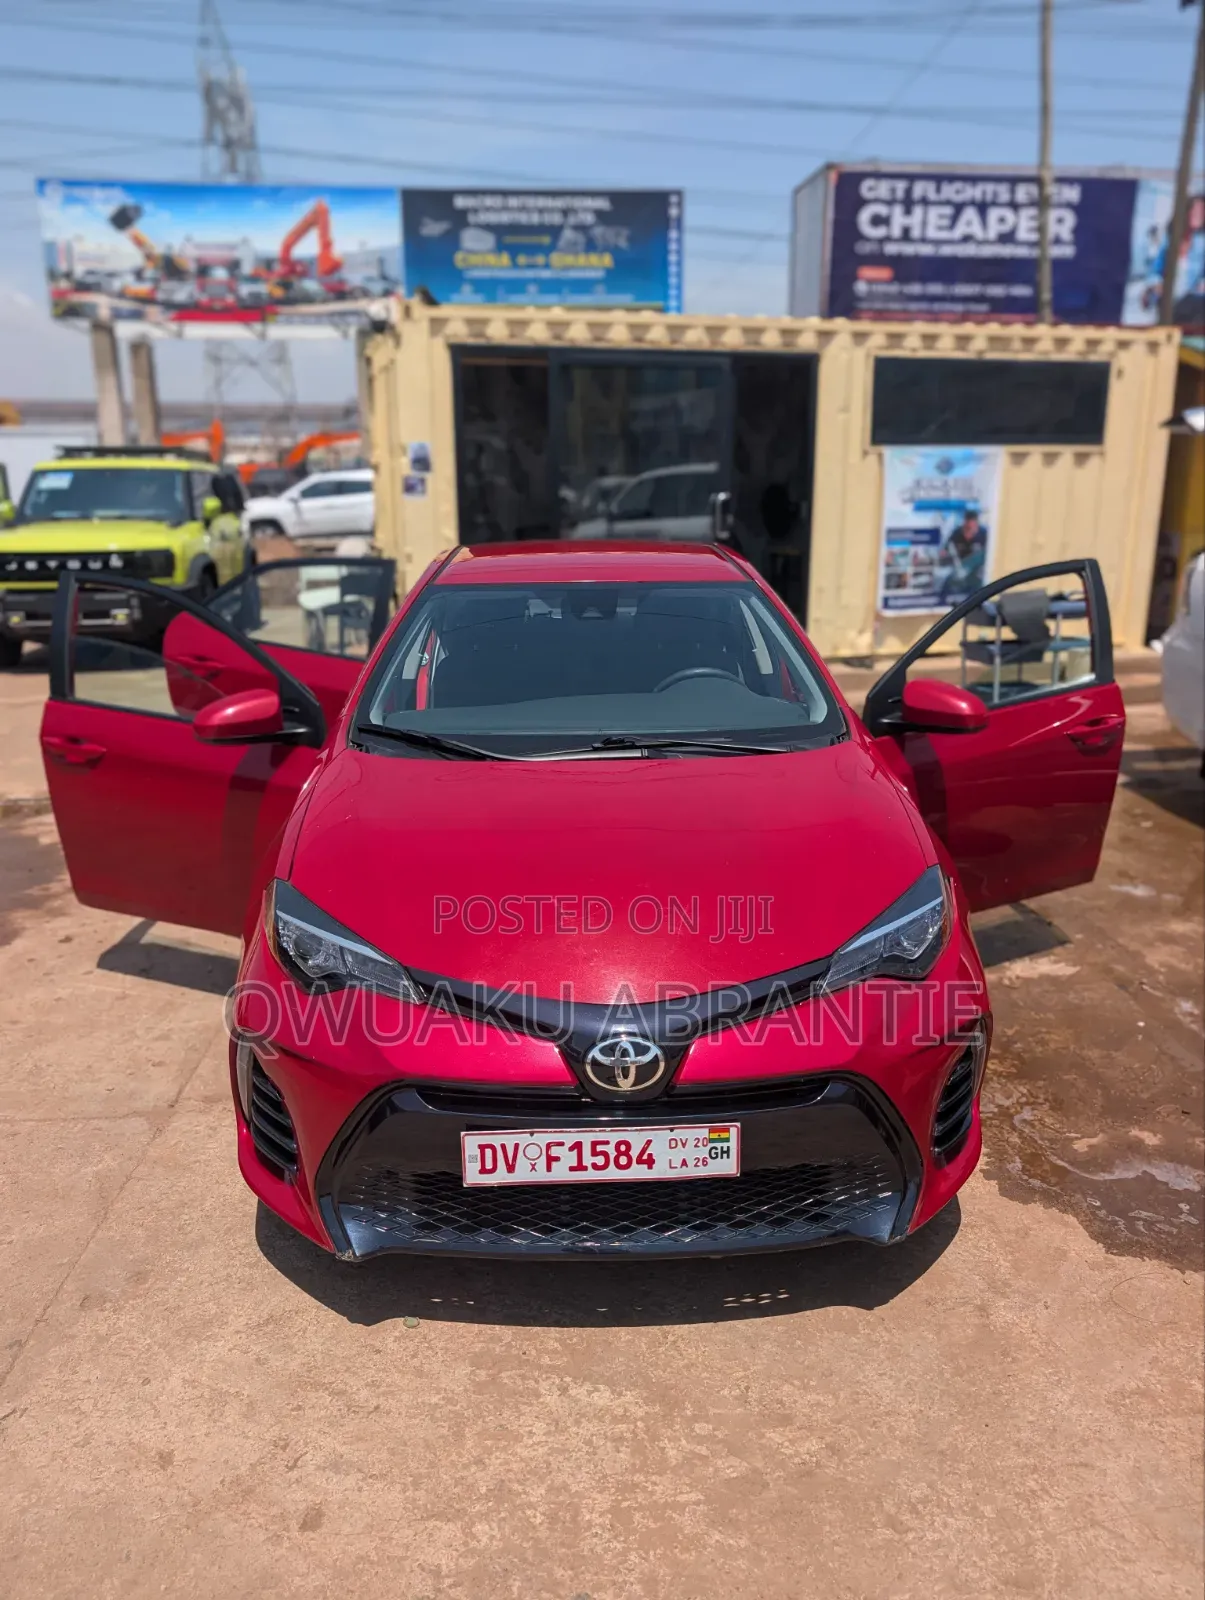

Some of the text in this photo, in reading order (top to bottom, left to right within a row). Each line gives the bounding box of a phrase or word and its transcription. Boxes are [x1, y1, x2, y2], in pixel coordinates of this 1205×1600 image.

[859, 178, 909, 200] GET
[912, 180, 1010, 203] FLIGHTS
[856, 202, 1077, 241] CHEAPER
[454, 252, 614, 269] CHINA GHANA
[668, 1136, 709, 1149] DV 20
[477, 1139, 656, 1175] DV F1584
[708, 1145, 731, 1160] GH
[668, 1156, 709, 1169] LA 26
